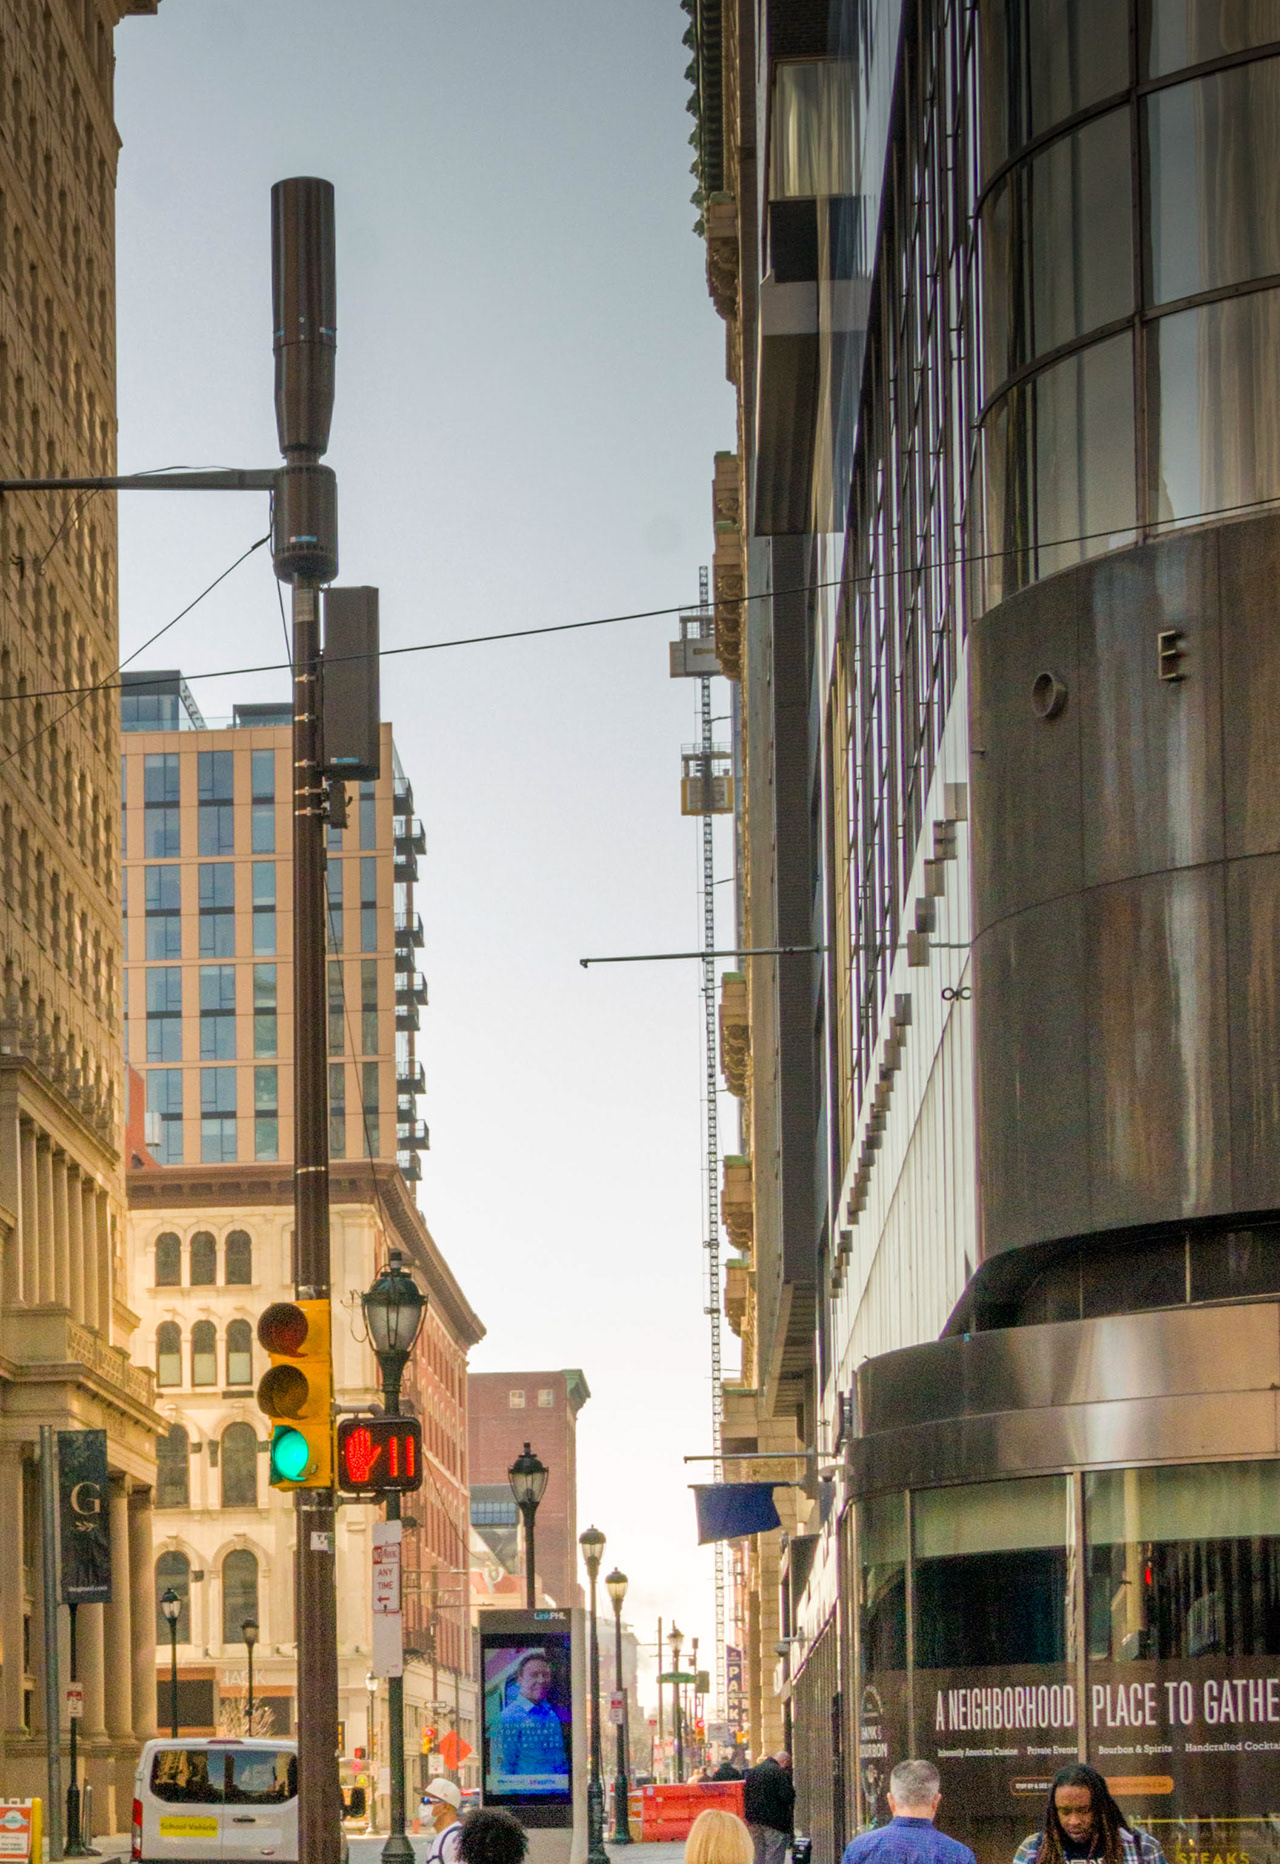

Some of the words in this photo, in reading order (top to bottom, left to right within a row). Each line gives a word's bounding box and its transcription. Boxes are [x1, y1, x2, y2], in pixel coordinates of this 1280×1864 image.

[389, 1436, 415, 1477] 11
[70, 1481, 101, 1515] G
[378, 1568, 393, 1577] ANY
[377, 1581, 393, 1590] TIME
[534, 1611, 566, 1621] LinkPHL
[935, 1690, 945, 1731] A
[948, 1685, 1076, 1731] NEIGHBORHOOD
[1092, 1682, 1158, 1728] PLACE
[1164, 1680, 1194, 1725] TO
[1203, 1678, 1280, 1724] GATHE
[965, 1748, 993, 1756] American
[994, 1747, 1018, 1756] Cuisine
[1027, 1746, 1052, 1755] Private
[1053, 1745, 1078, 1755] Events
[1098, 1745, 1134, 1755] Bourbon
[1135, 1744, 1143, 1753] &
[1143, 1744, 1173, 1756] Spirits
[1185, 1742, 1243, 1753] Handcrafted
[160, 1822, 187, 1831] School
[188, 1822, 218, 1832] Vehicle
